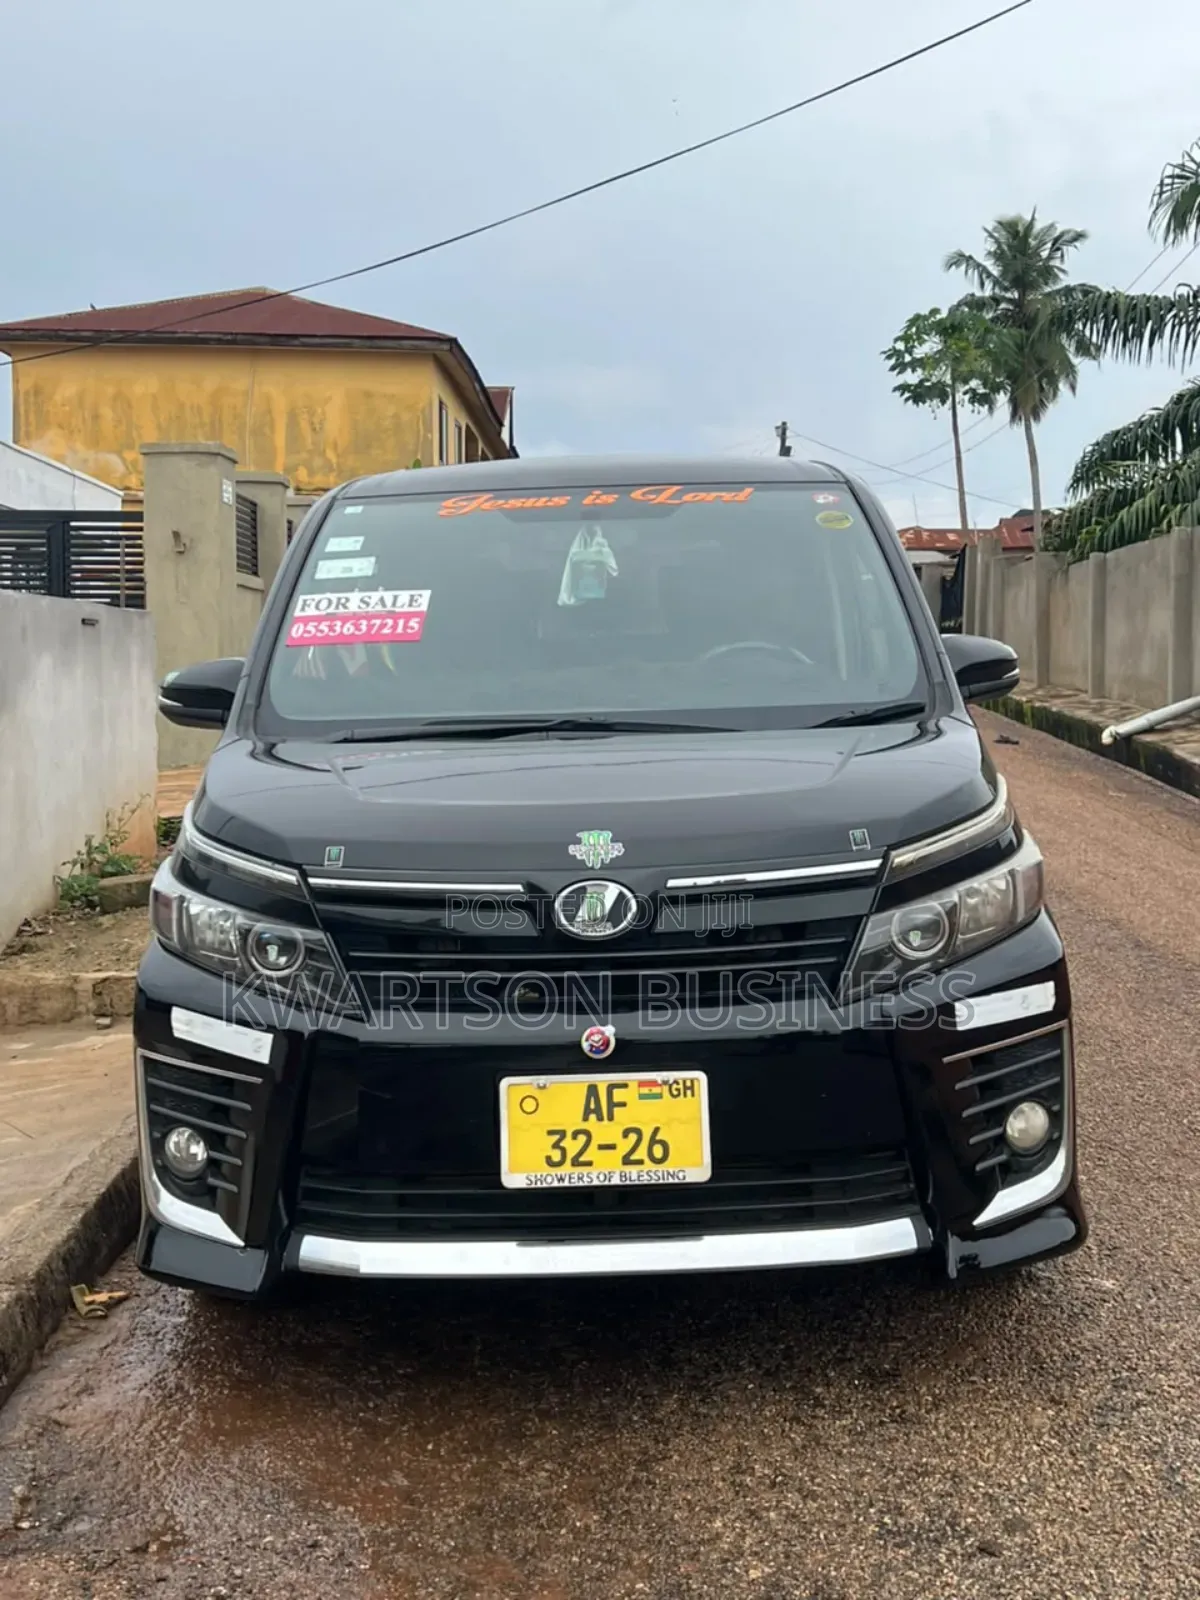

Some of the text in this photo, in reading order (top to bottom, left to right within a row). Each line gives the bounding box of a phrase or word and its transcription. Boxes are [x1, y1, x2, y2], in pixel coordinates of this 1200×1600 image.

[438, 485, 755, 517] Jesus is Lord
[299, 593, 423, 613] FOR SALE
[290, 618, 421, 639] 0553637215
[668, 1079, 696, 1098] GH
[581, 1083, 630, 1122] AF
[544, 1126, 670, 1168] 32-26
[525, 1169, 687, 1187] SHOWERS OF BLESSING
